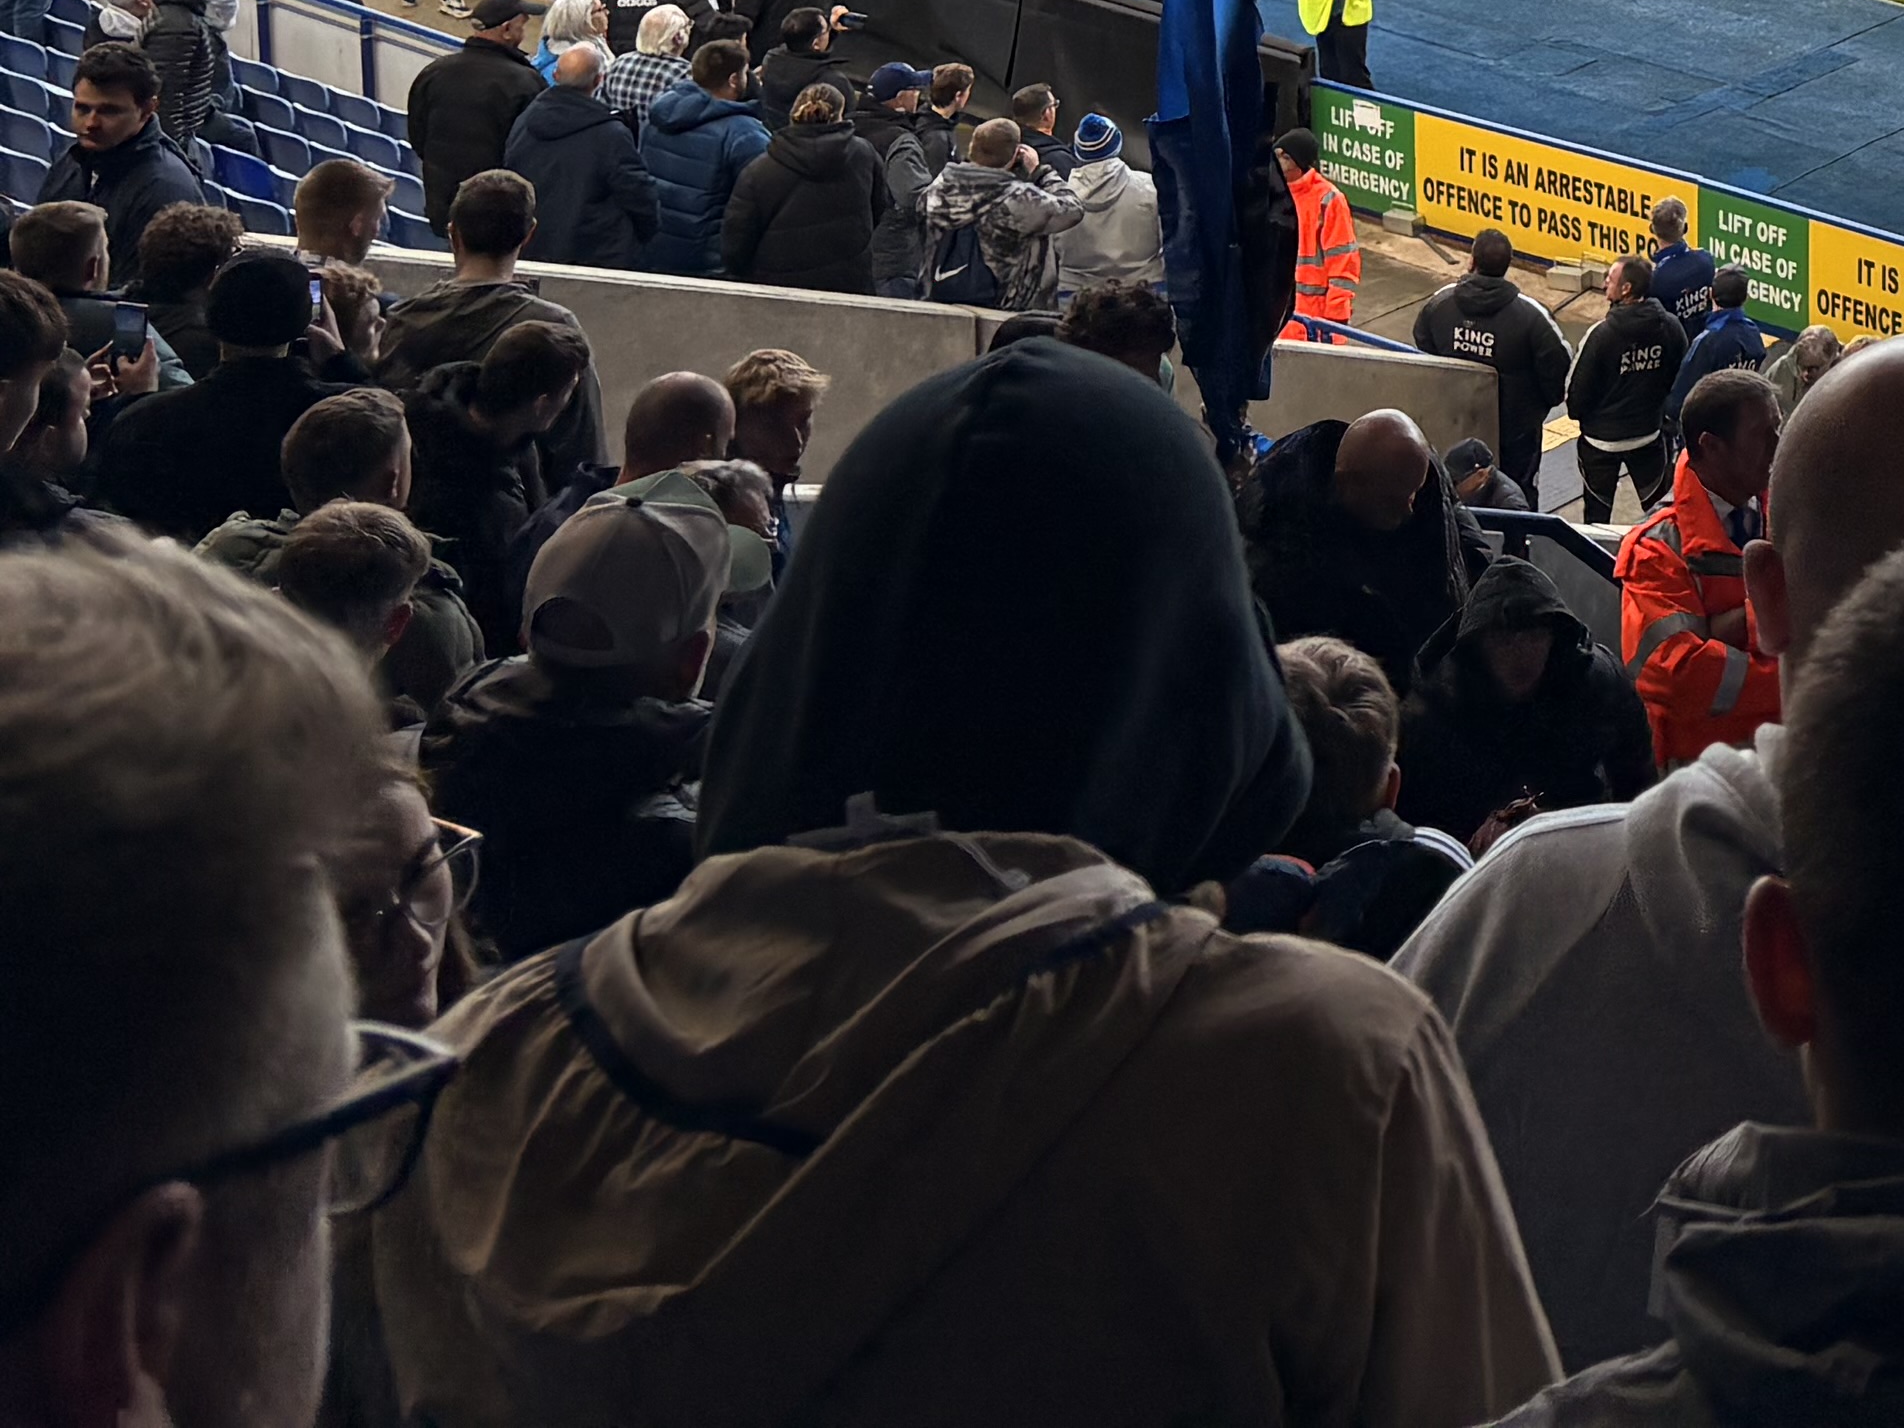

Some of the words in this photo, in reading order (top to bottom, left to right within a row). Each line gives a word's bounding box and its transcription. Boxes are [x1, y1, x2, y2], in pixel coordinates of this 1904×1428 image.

[1323, 132, 1339, 153] IN
[1342, 137, 1381, 167] CASE
[1384, 150, 1405, 172] OF
[1320, 158, 1411, 201] EMERGENCY
[1459, 145, 1476, 173] IT
[1482, 151, 1498, 180] IS
[1504, 157, 1529, 188] AN
[1535, 165, 1651, 221] ARRESTABLE
[1423, 176, 1502, 222] OFFENCE
[1508, 199, 1531, 229] TO
[1538, 206, 1582, 243] PASS
[1588, 220, 1629, 255] THIS
[1719, 208, 1752, 237] LIFT
[1757, 221, 1788, 248] OFF
[1709, 235, 1726, 260] IN
[1730, 243, 1771, 276] CASE
[1776, 258, 1797, 281] OF
[1857, 256, 1876, 288] IT
[1881, 263, 1898, 294] IS
[1676, 285, 1708, 312] KING
[1816, 288, 1902, 337] OFFENCE
[1453, 326, 1495, 347] KING
[1453, 341, 1493, 358] POWER
[1621, 345, 1662, 365] KING
